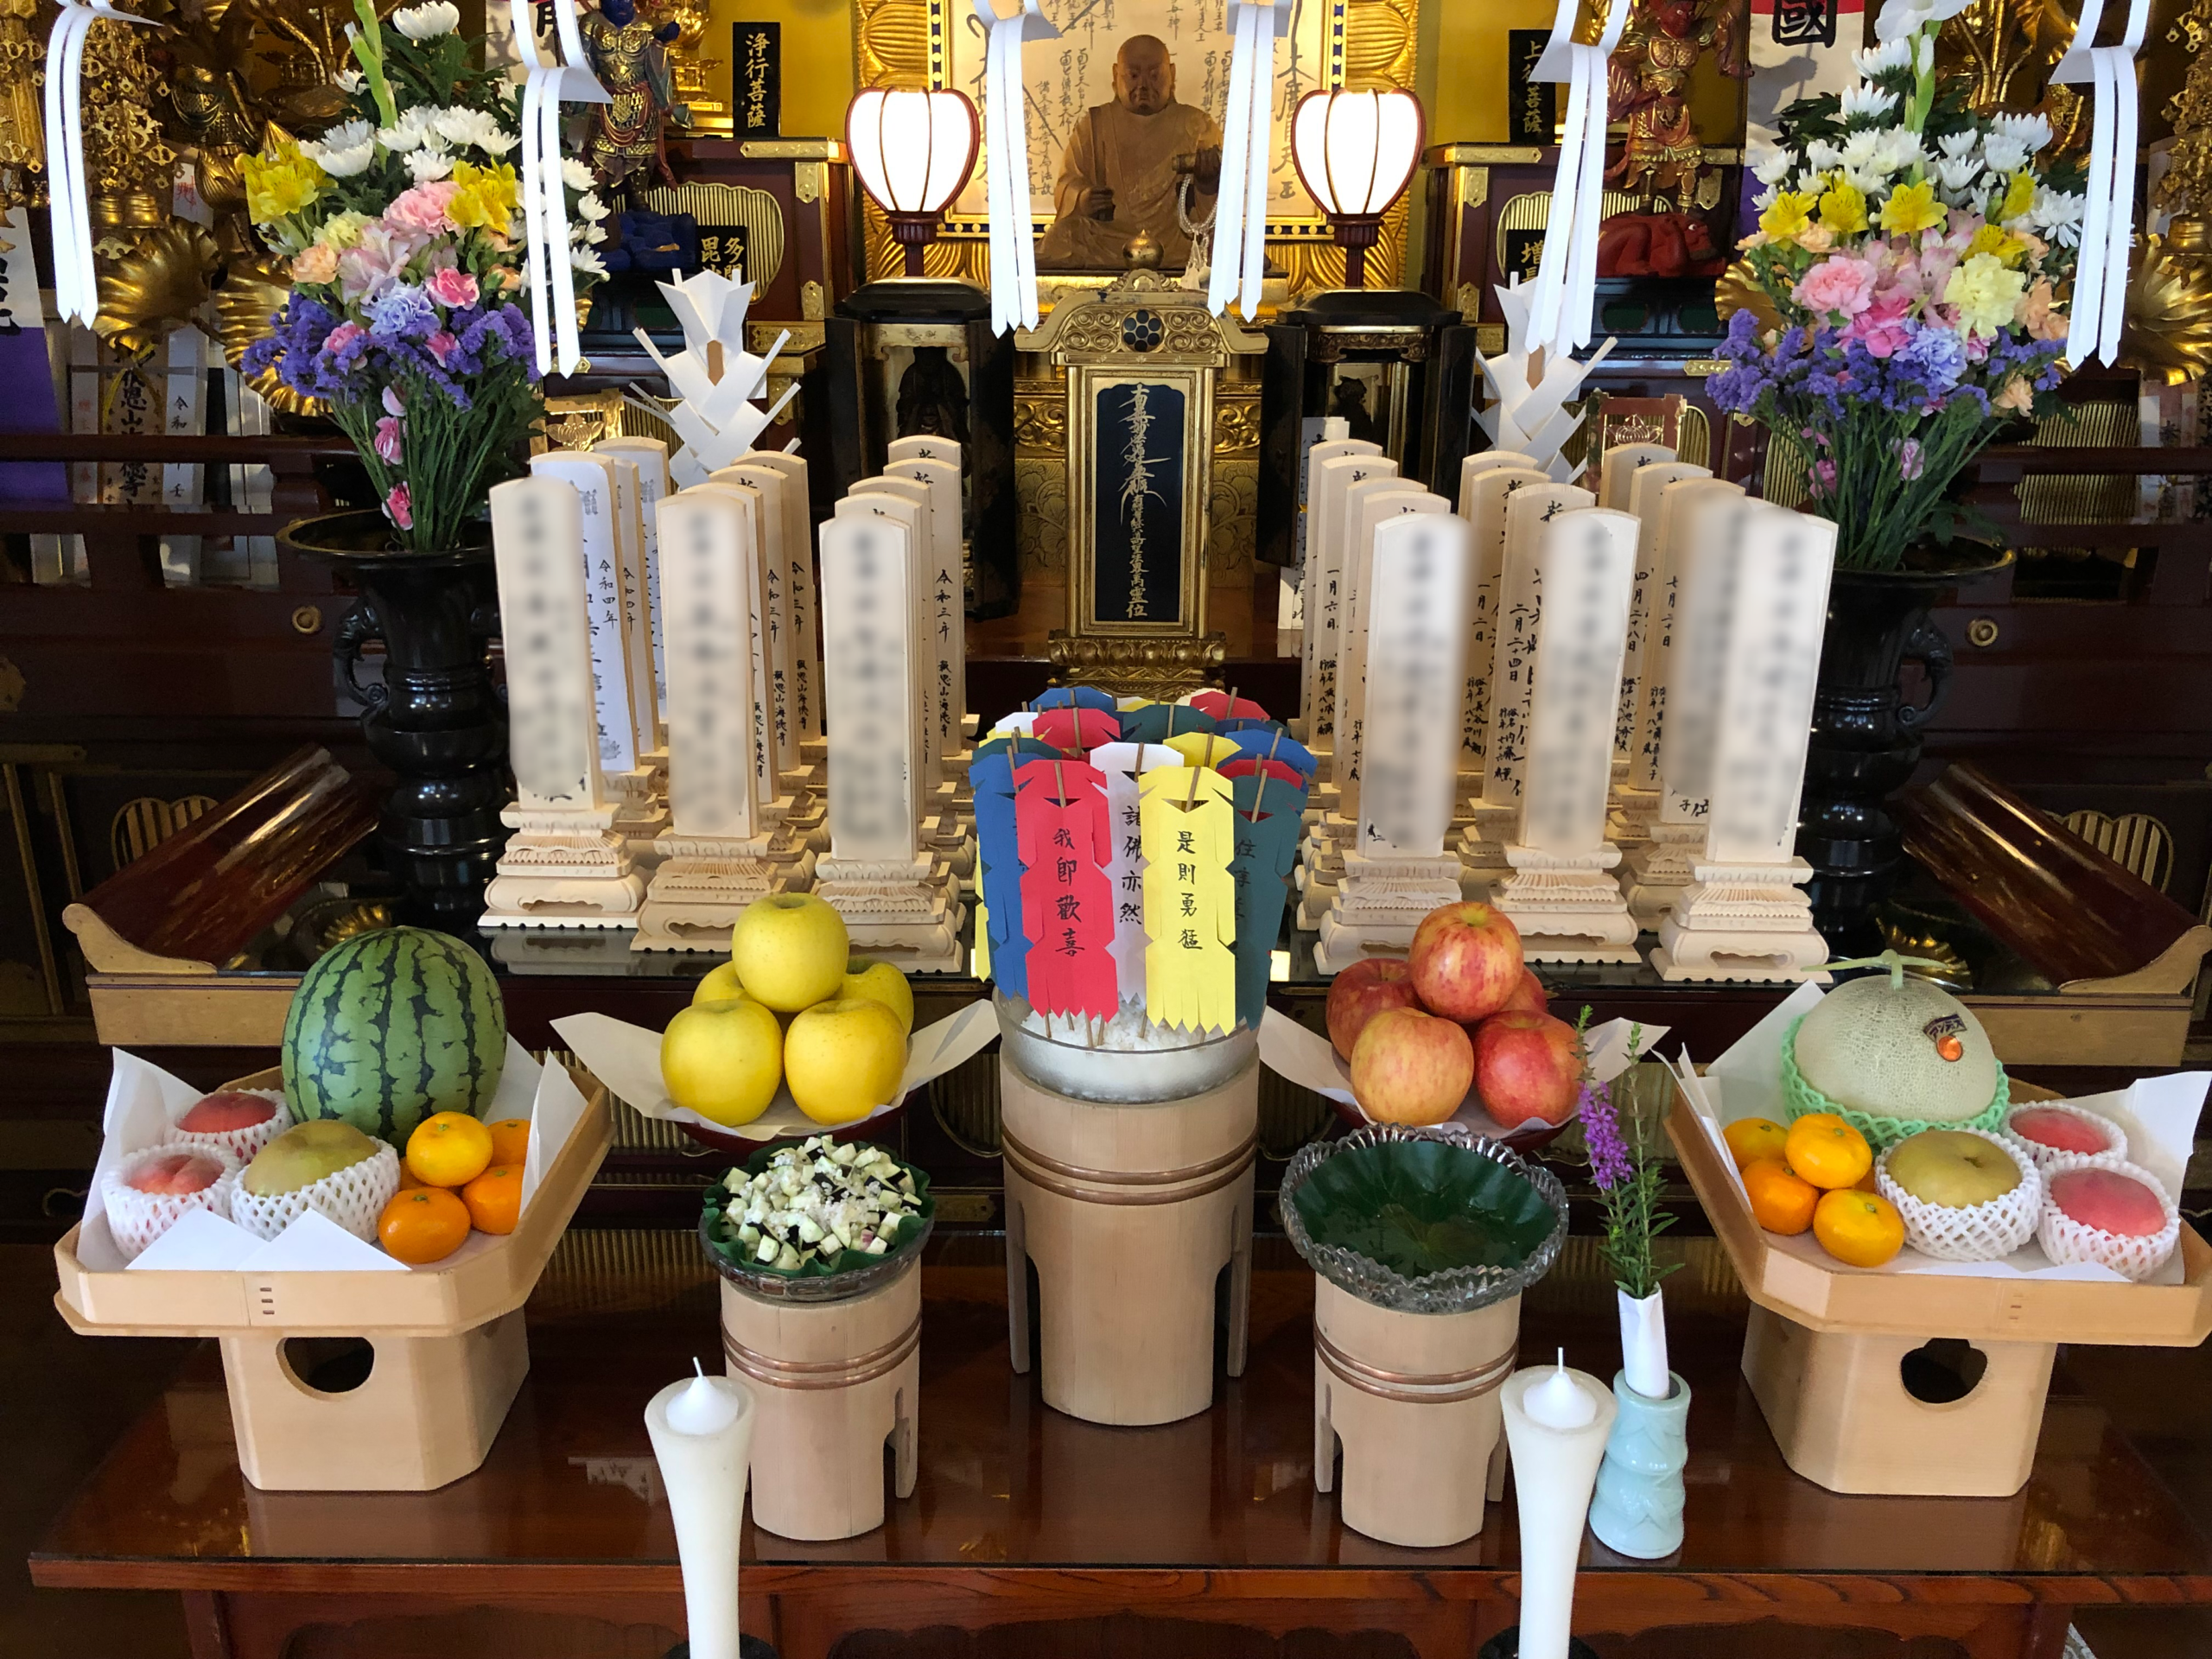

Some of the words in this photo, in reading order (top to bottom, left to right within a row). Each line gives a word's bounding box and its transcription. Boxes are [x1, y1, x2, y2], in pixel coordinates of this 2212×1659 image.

[745, 33, 771, 129] 浄行菩薩
[599, 558, 618, 630] 令和四年
[767, 569, 781, 644] 令和三年
[934, 569, 953, 644] 令和三年
[1324, 569, 1340, 631] 一月六日
[1472, 584, 1491, 643] 一月二日
[1627, 571, 1649, 652] 四月二十八日
[1506, 603, 1529, 683] 二月二十四日
